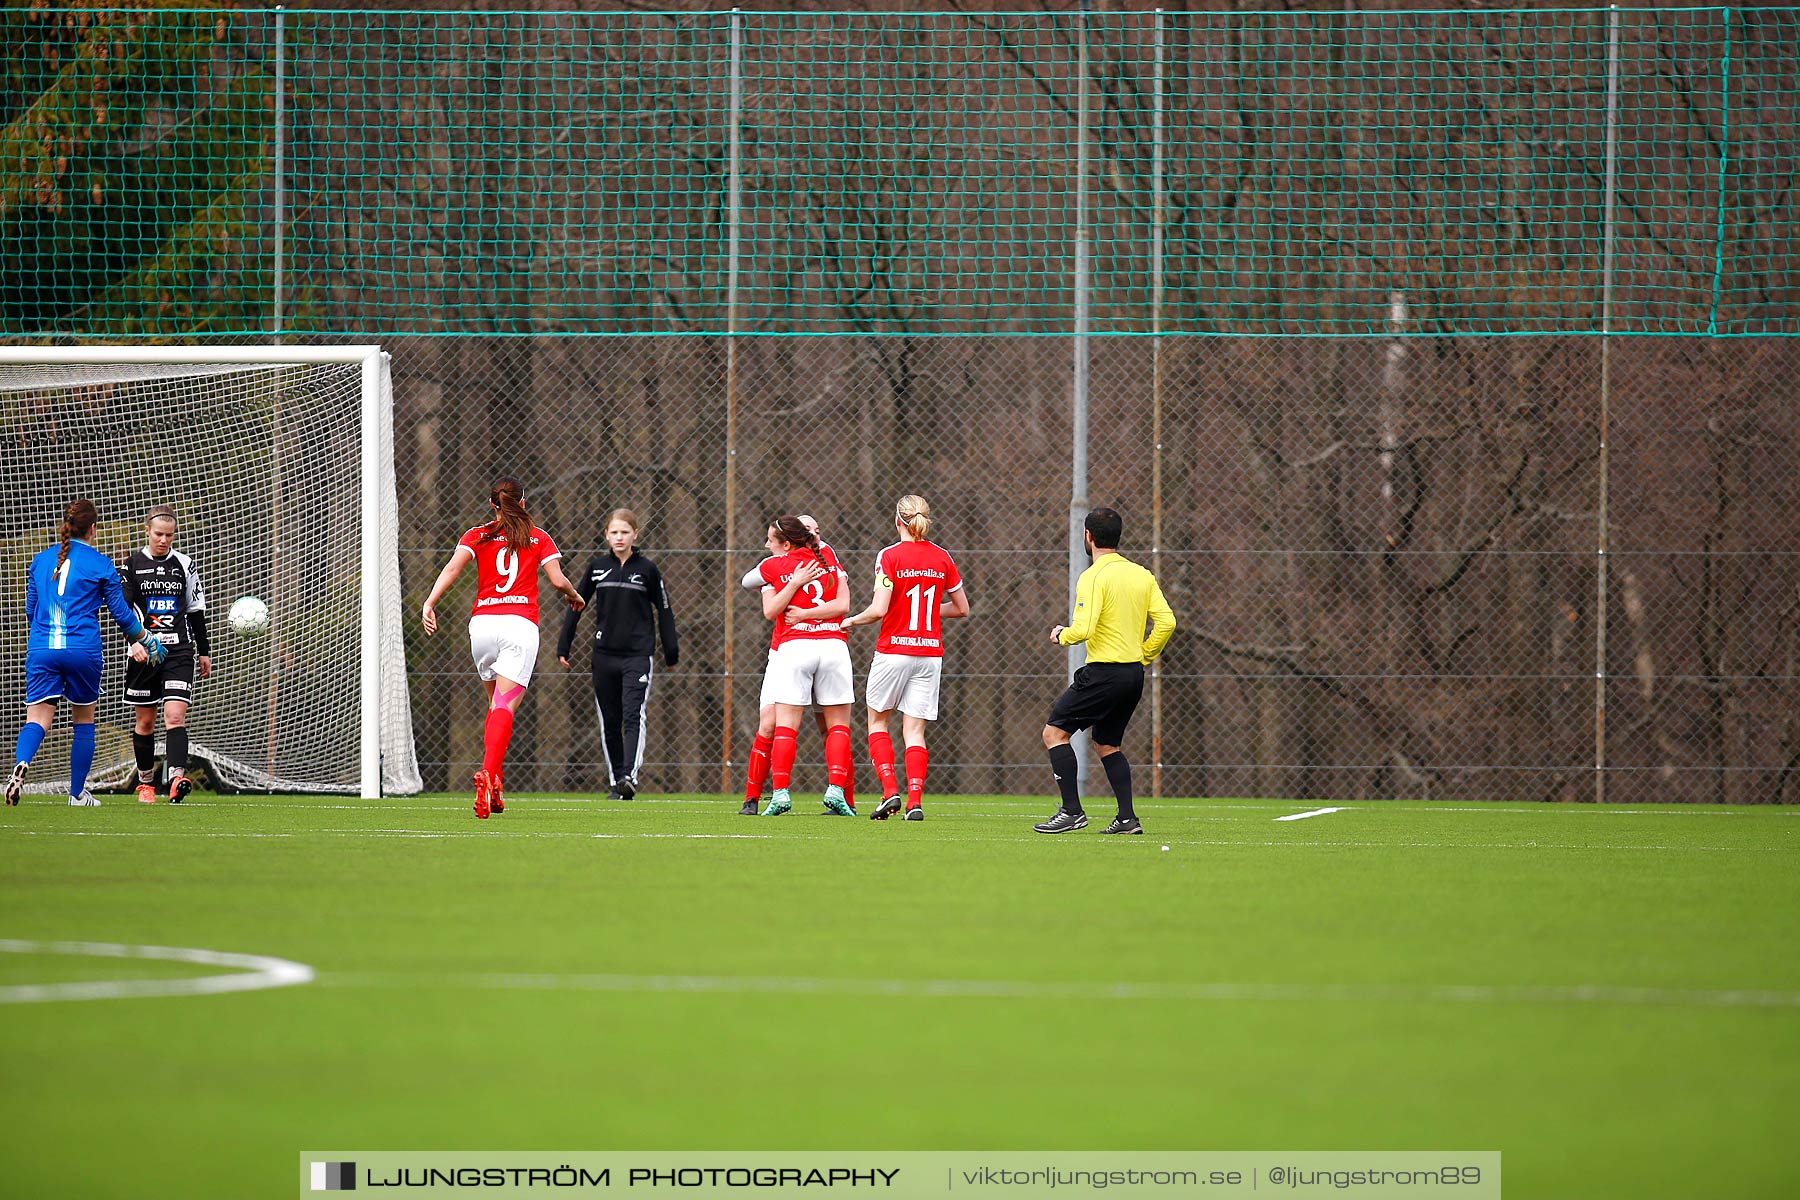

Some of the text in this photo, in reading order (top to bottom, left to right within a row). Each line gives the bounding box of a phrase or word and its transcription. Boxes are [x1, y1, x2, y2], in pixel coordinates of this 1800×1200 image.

[53, 558, 71, 597] 1
[140, 579, 183, 592] ritningen
[496, 546, 519, 593] 9
[896, 568, 945, 579] Uddevalla.se
[802, 579, 825, 622] 3
[905, 583, 937, 632] 11
